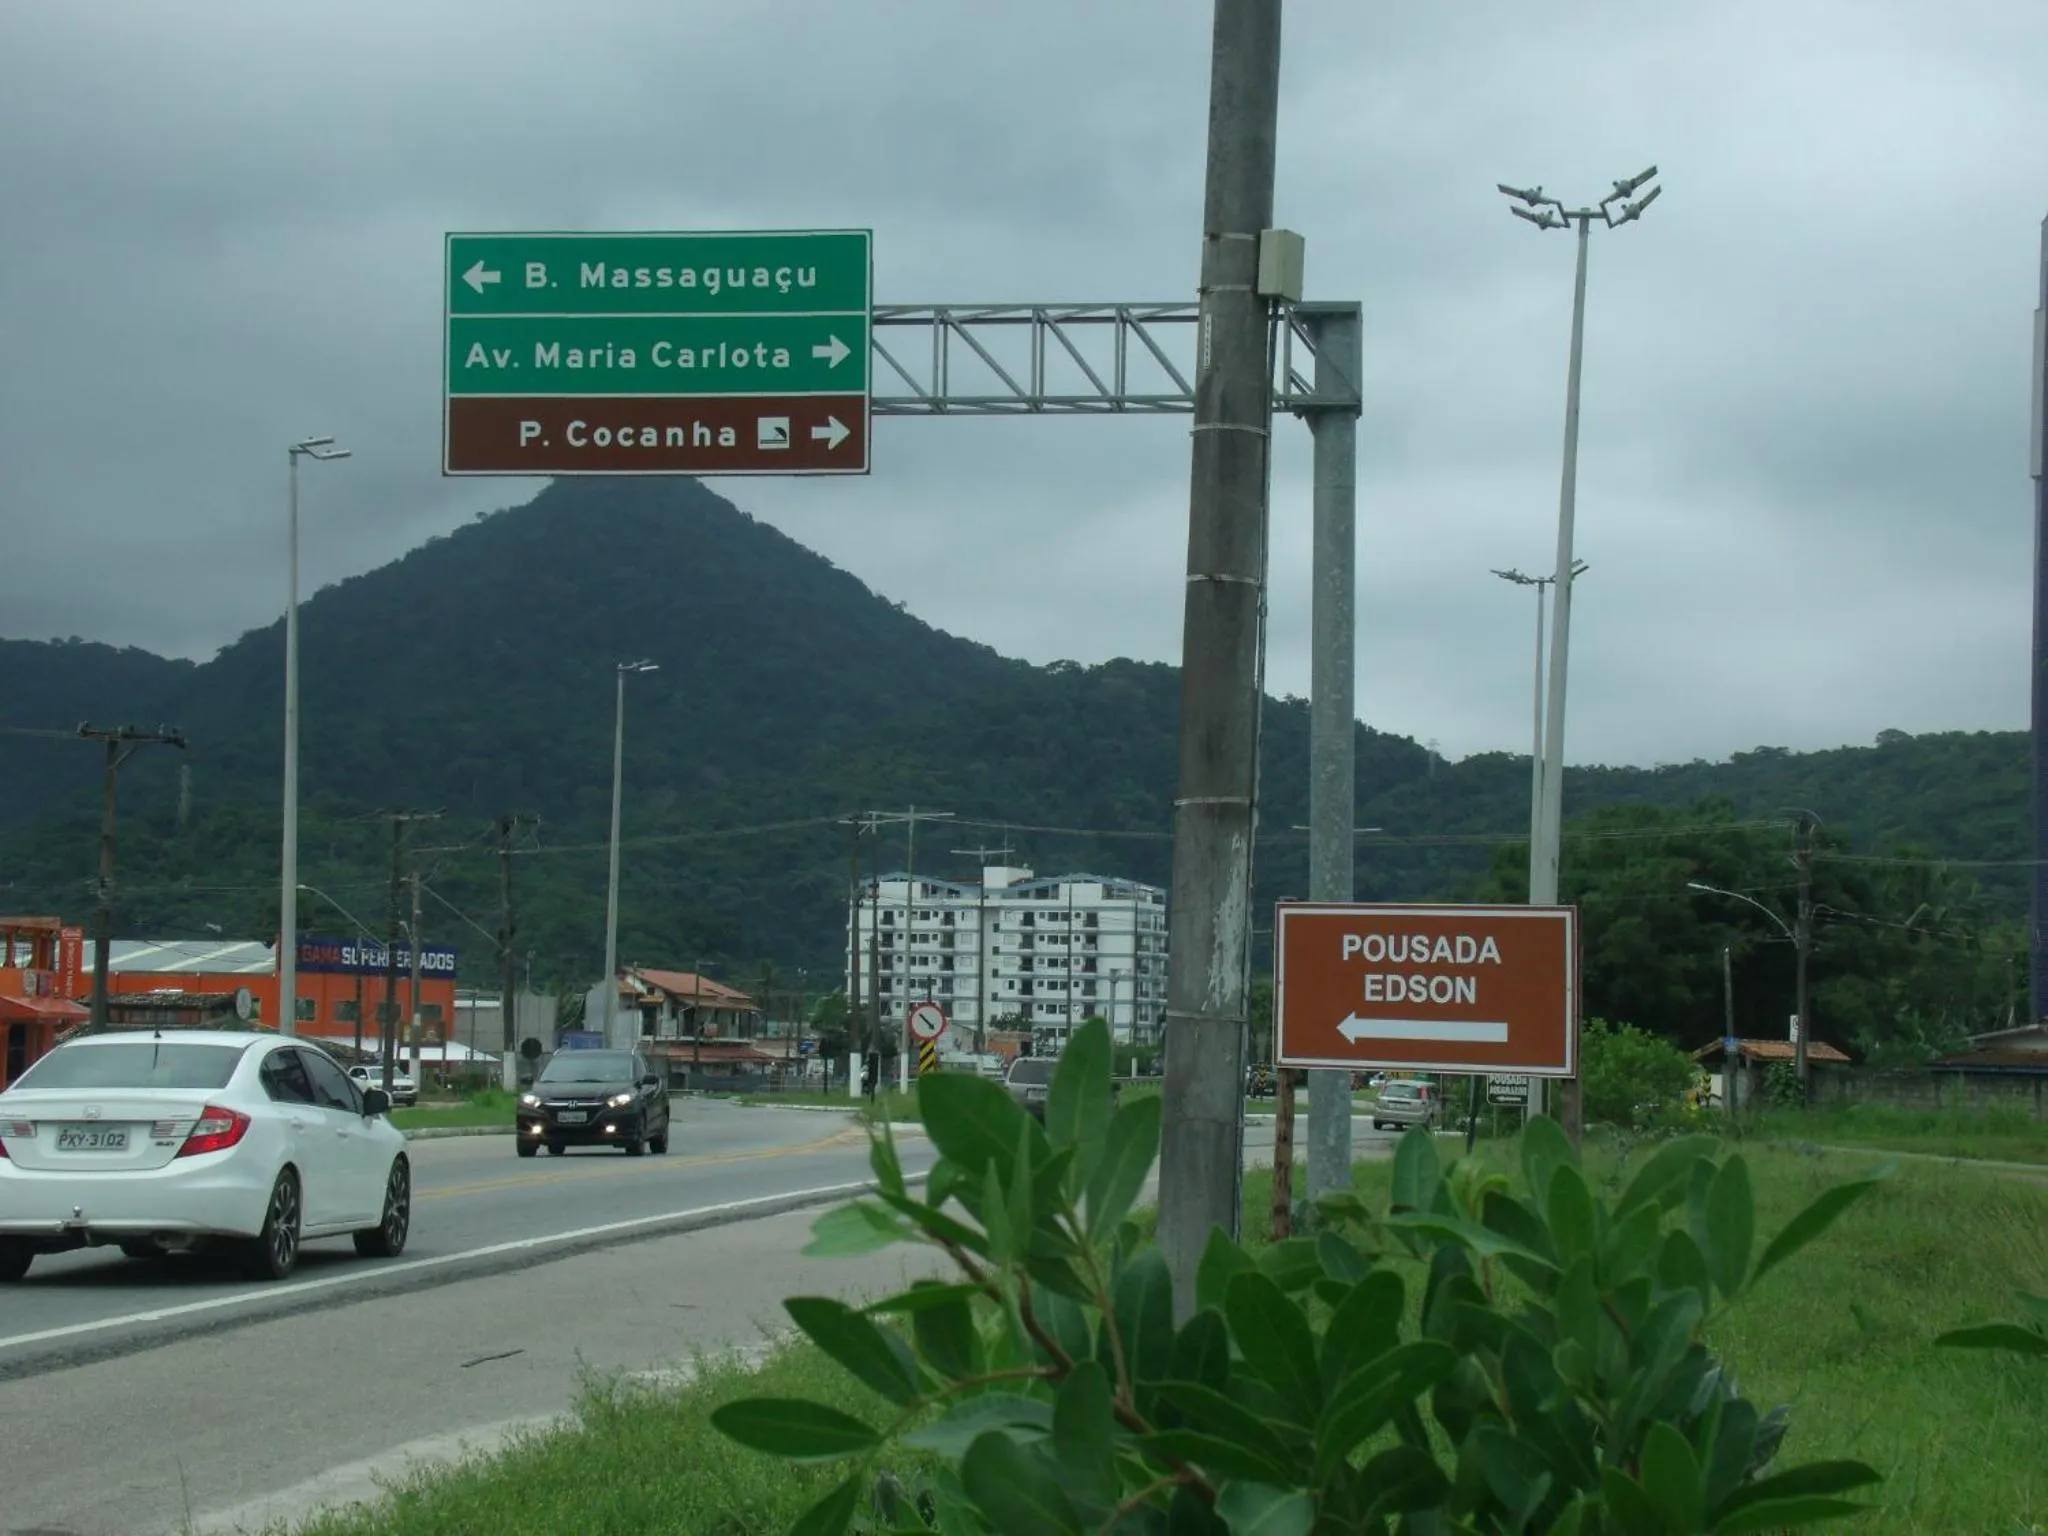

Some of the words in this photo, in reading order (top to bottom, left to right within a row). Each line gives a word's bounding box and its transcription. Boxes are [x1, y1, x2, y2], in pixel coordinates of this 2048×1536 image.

[525, 262, 557, 288] B.
[580, 262, 817, 295] Massaguaçu
[465, 342, 519, 368] Av.
[535, 342, 637, 368] Maria
[651, 341, 791, 368] Carlota
[519, 421, 549, 447] P.
[566, 420, 736, 447] Cocanha
[341, 946, 455, 971] SUPERERADOS
[1342, 934, 1502, 964] POUSADA
[1364, 974, 1477, 1004] EDSON
